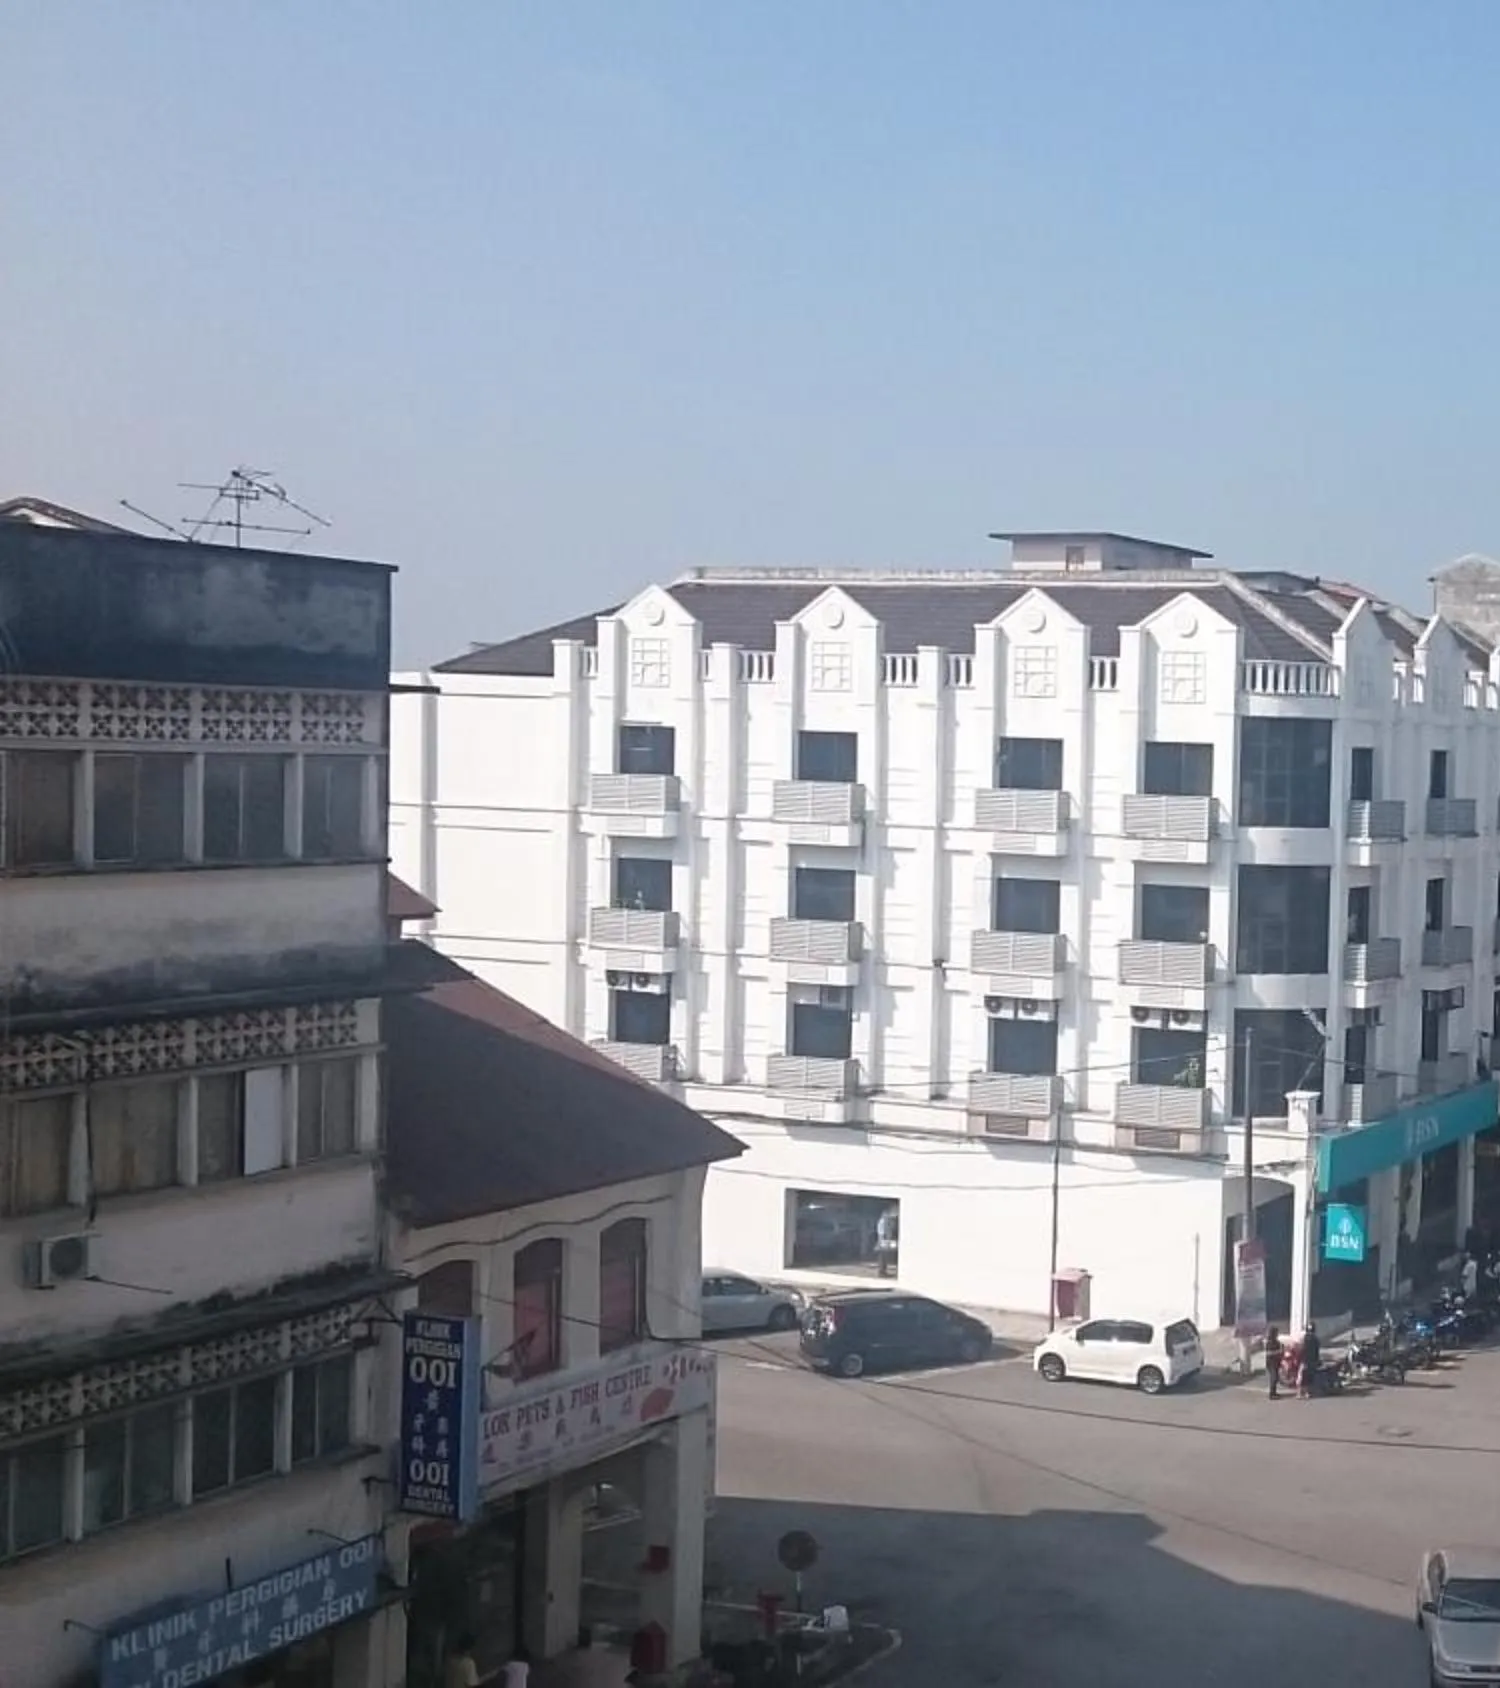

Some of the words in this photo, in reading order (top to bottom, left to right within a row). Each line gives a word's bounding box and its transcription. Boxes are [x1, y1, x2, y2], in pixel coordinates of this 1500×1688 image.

[1330, 1233, 1359, 1250] BSN
[409, 1355, 457, 1388] OOI
[516, 1397, 551, 1430] PETS
[409, 1458, 450, 1486] OOI
[111, 1610, 198, 1662] KLINIK
[207, 1555, 332, 1624] PERGIGIAN
[339, 1538, 375, 1570] OOI
[162, 1641, 259, 1688] DENTAL
[267, 1588, 369, 1650] SURGERY
